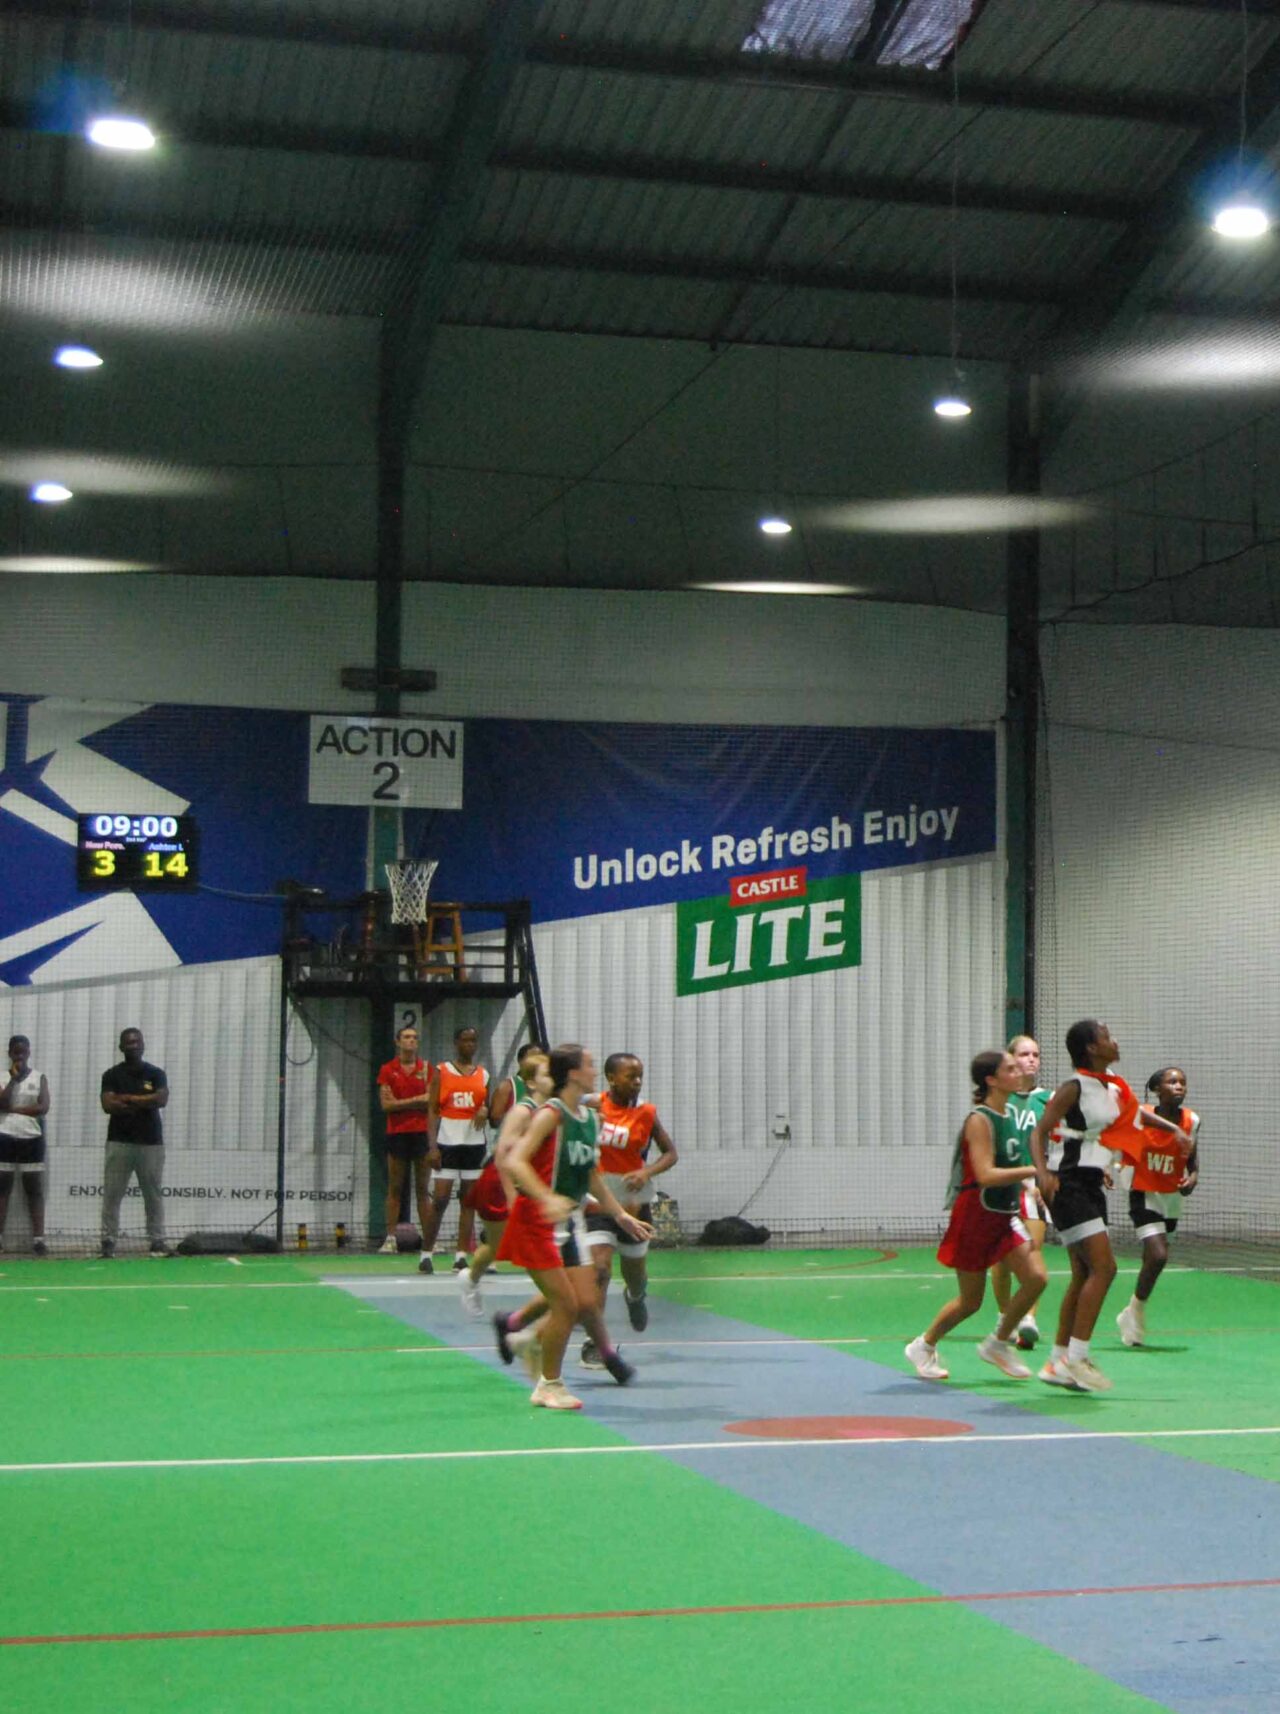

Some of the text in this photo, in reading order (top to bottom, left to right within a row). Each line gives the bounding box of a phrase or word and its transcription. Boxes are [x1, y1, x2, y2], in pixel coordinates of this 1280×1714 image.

[316, 724, 456, 759] ACTION
[372, 762, 401, 801] 2
[95, 815, 178, 837] 09:00
[574, 803, 960, 890] Unlock Refresh Enjoy
[94, 850, 115, 876] 3
[145, 851, 189, 877] 14
[736, 875, 799, 899] CASTLE
[690, 898, 847, 981] LITE
[453, 1091, 475, 1107] GK
[125, 1186, 226, 1198] REONSIBLY.
[231, 1188, 260, 1200] NOT
